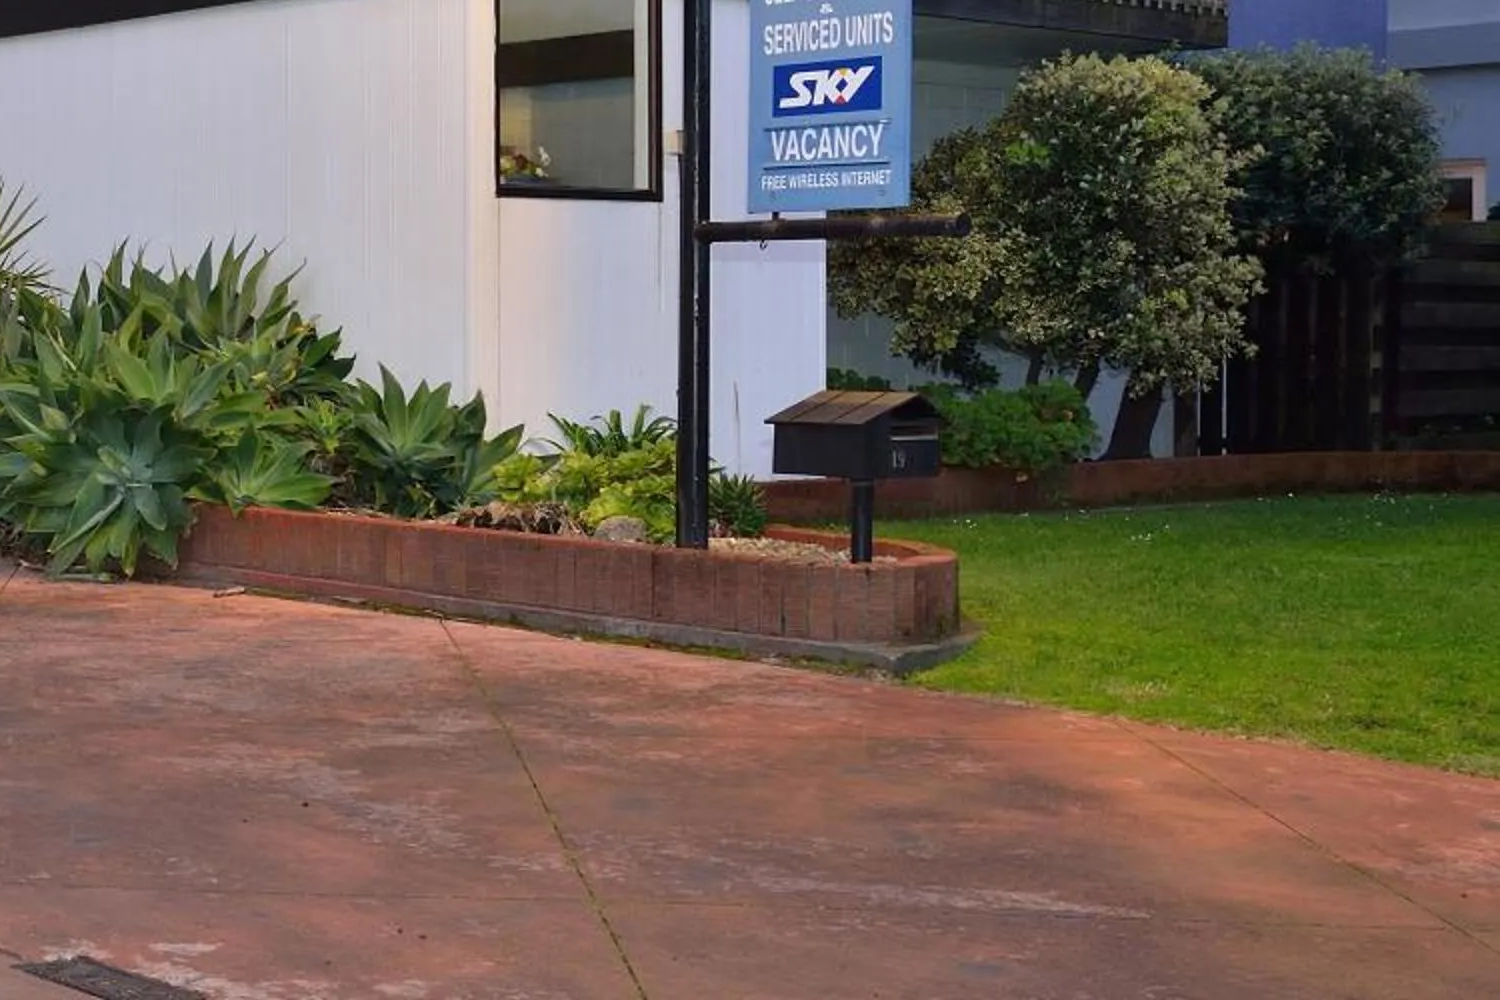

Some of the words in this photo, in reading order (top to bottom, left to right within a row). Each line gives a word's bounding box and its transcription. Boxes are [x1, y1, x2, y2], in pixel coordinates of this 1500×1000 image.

[764, 17, 840, 55] SERVICED
[845, 11, 893, 47] UNITS
[779, 65, 875, 109] SKY
[771, 123, 884, 161] VACANCY
[761, 174, 787, 190] FREE
[789, 171, 839, 188] WIRELESS
[841, 169, 892, 186] INTERNET
